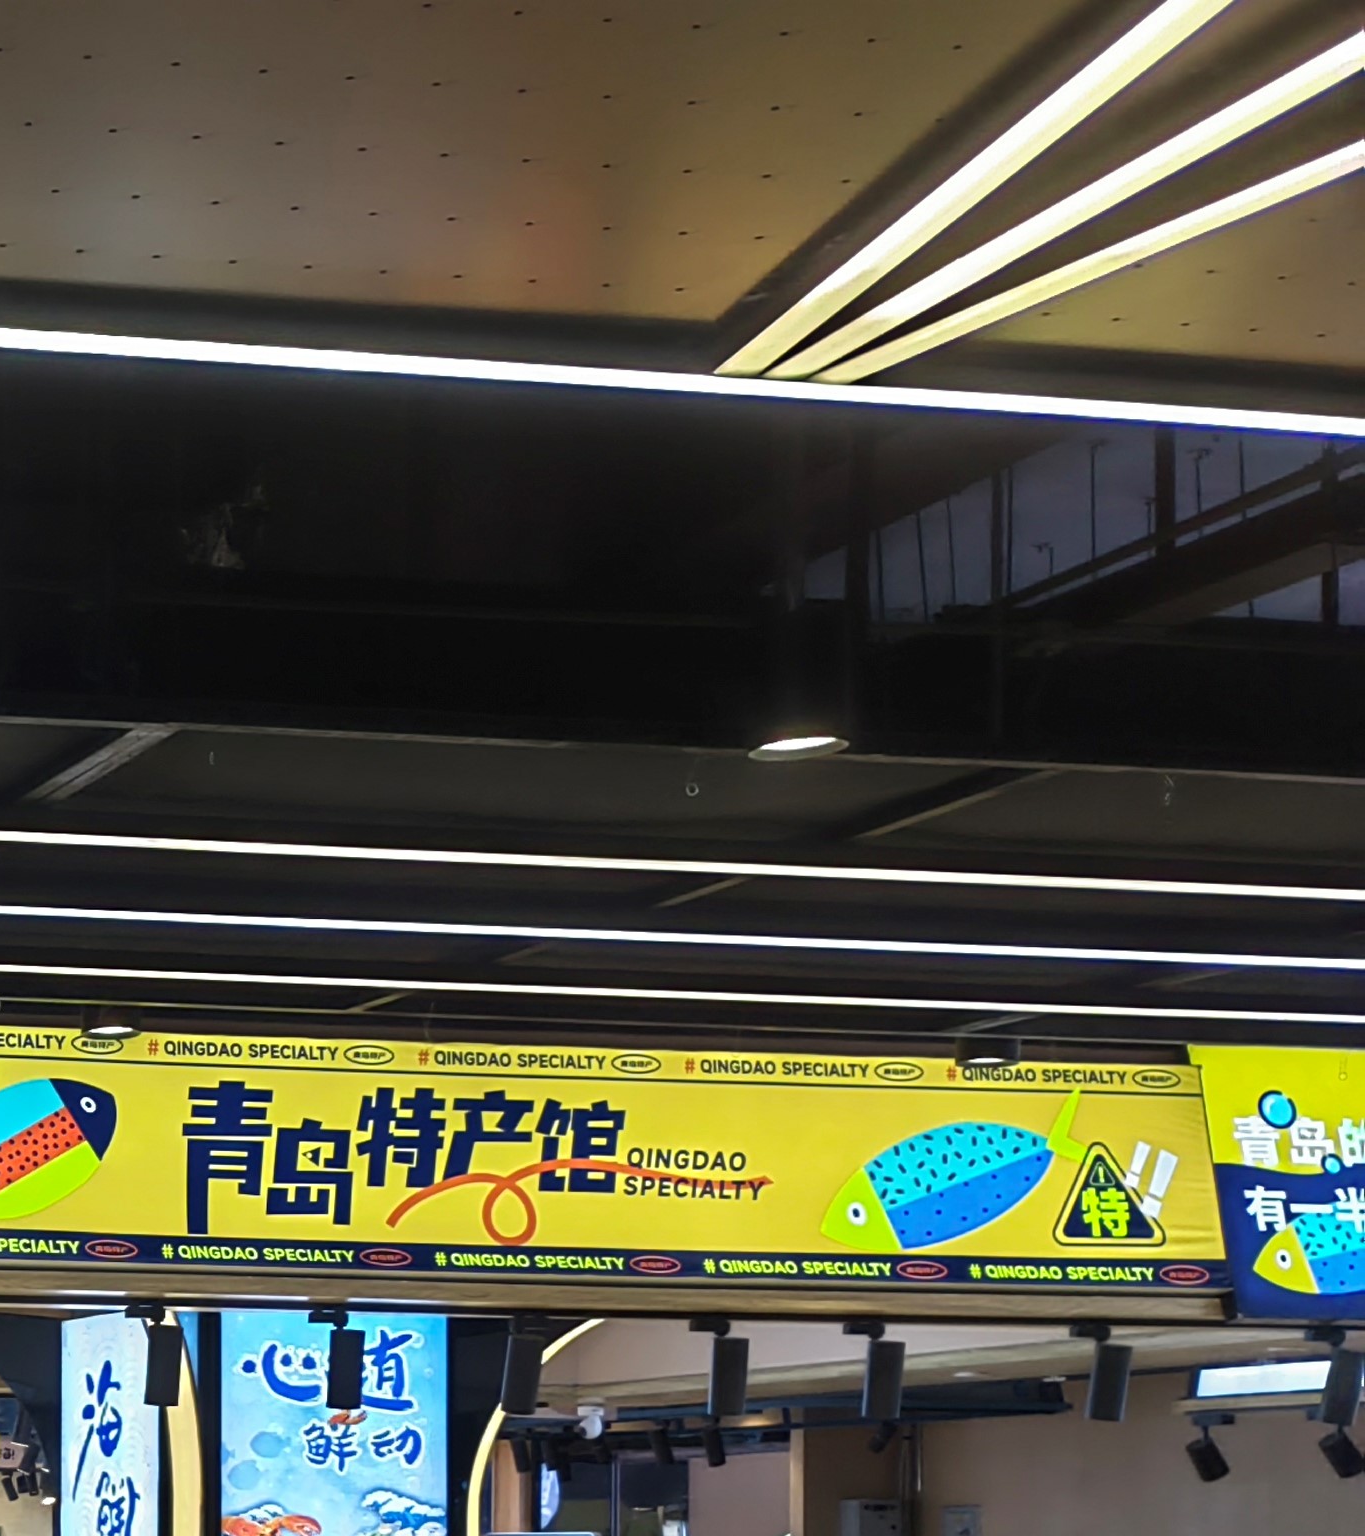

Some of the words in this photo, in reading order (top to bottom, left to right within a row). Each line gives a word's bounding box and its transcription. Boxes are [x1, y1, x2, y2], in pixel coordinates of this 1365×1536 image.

[164, 1040, 243, 1058] QINGDAO
[248, 1042, 339, 1061] SPECIALTY
[434, 1050, 512, 1068] QINGDAO
[516, 1054, 607, 1071] SPECIALTY
[700, 1058, 777, 1076] QINGDAO
[781, 1061, 870, 1079] SPECIALTY
[961, 1066, 1038, 1083] QINGDAO
[1042, 1069, 1127, 1087] SPECIALTY
[182, 1079, 626, 1235] 青岛特产馆
[626, 1147, 747, 1171] QINGDAO
[623, 1175, 765, 1201] SPECIALTY
[1081, 1187, 1131, 1238] 特
[178, 1244, 258, 1262] QINGDAO
[262, 1246, 355, 1264] SPECIALTY
[450, 1253, 531, 1268] QINGDAO
[534, 1255, 624, 1272] SPECIALTY
[719, 1258, 798, 1275] QINGDAO
[802, 1260, 892, 1277] SPECIALTY
[985, 1264, 1063, 1281] QINGDAO
[1067, 1266, 1154, 1282] SPECIALTY
[302, 1420, 422, 1472] 鲜动
